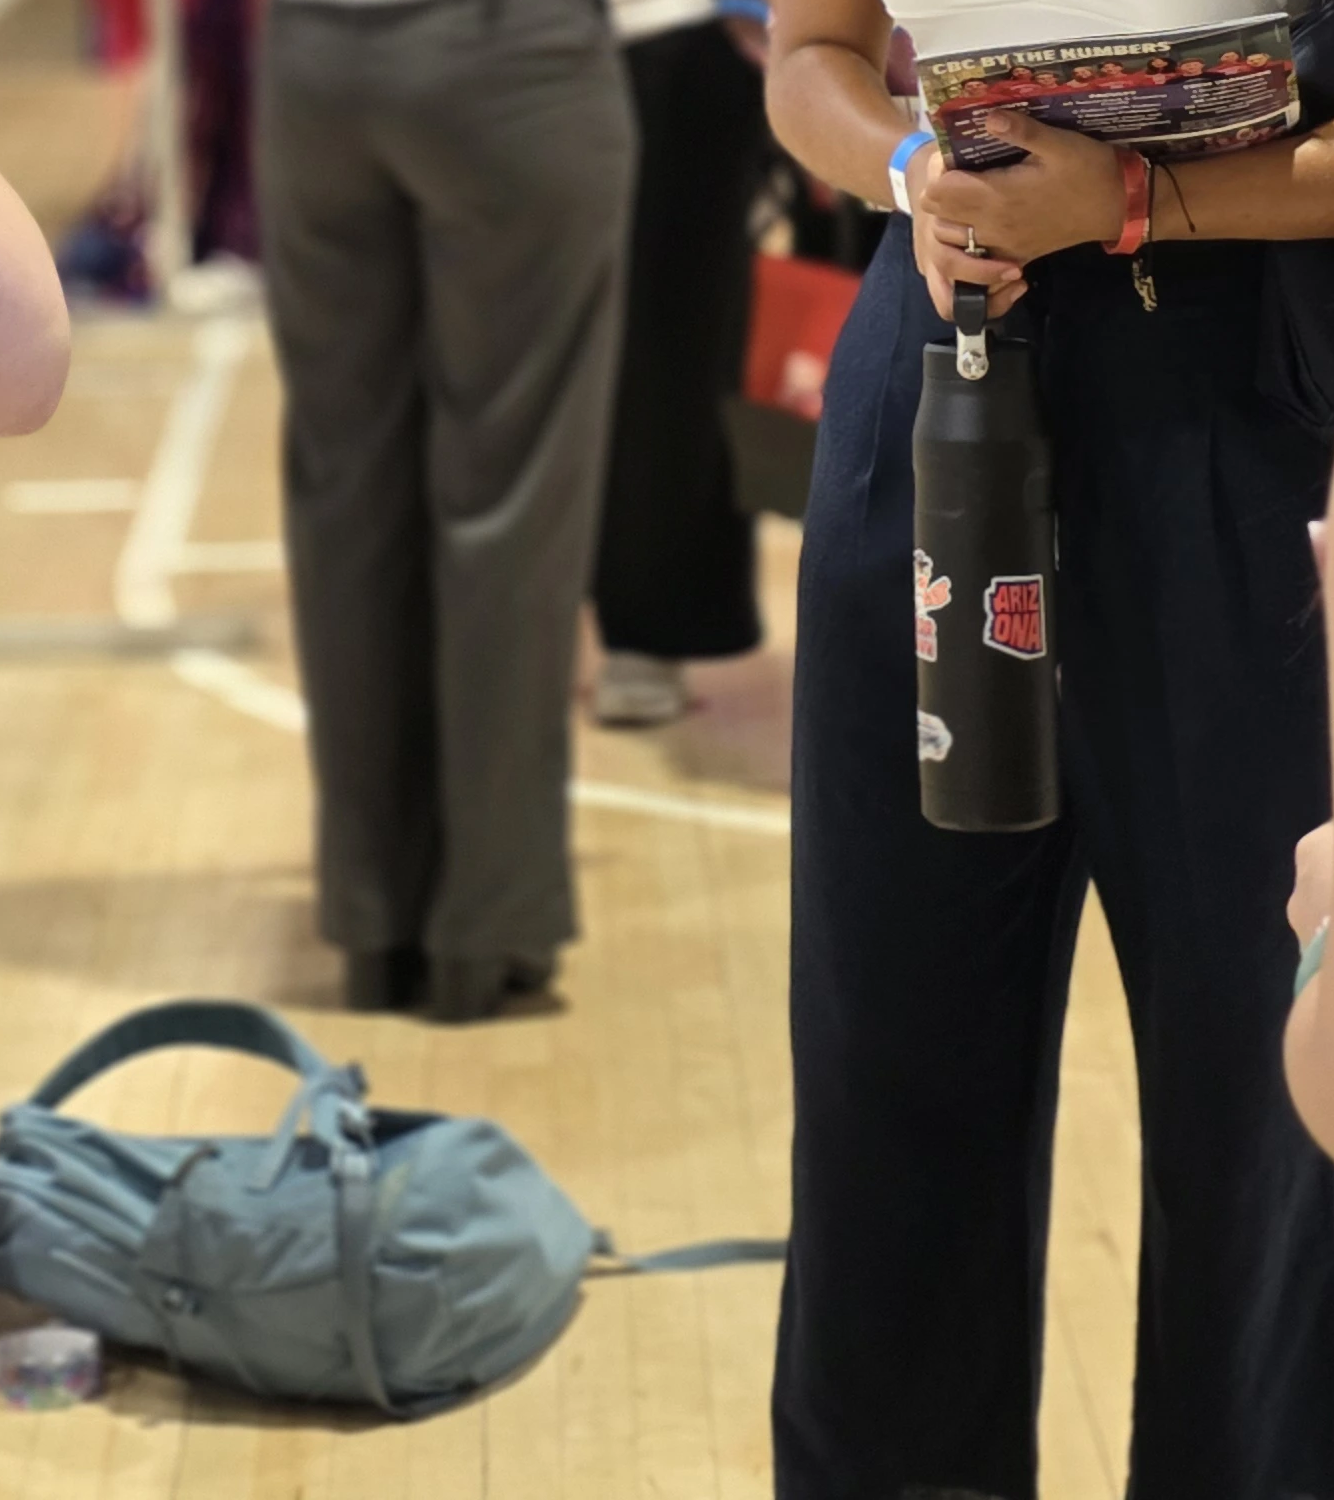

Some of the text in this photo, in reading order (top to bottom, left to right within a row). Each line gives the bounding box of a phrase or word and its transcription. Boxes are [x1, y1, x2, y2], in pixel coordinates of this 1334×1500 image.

[932, 41, 1172, 76] CBC BY THE NUMBERS
[993, 583, 1040, 613] ARIZ
[993, 611, 1041, 651] ONA
